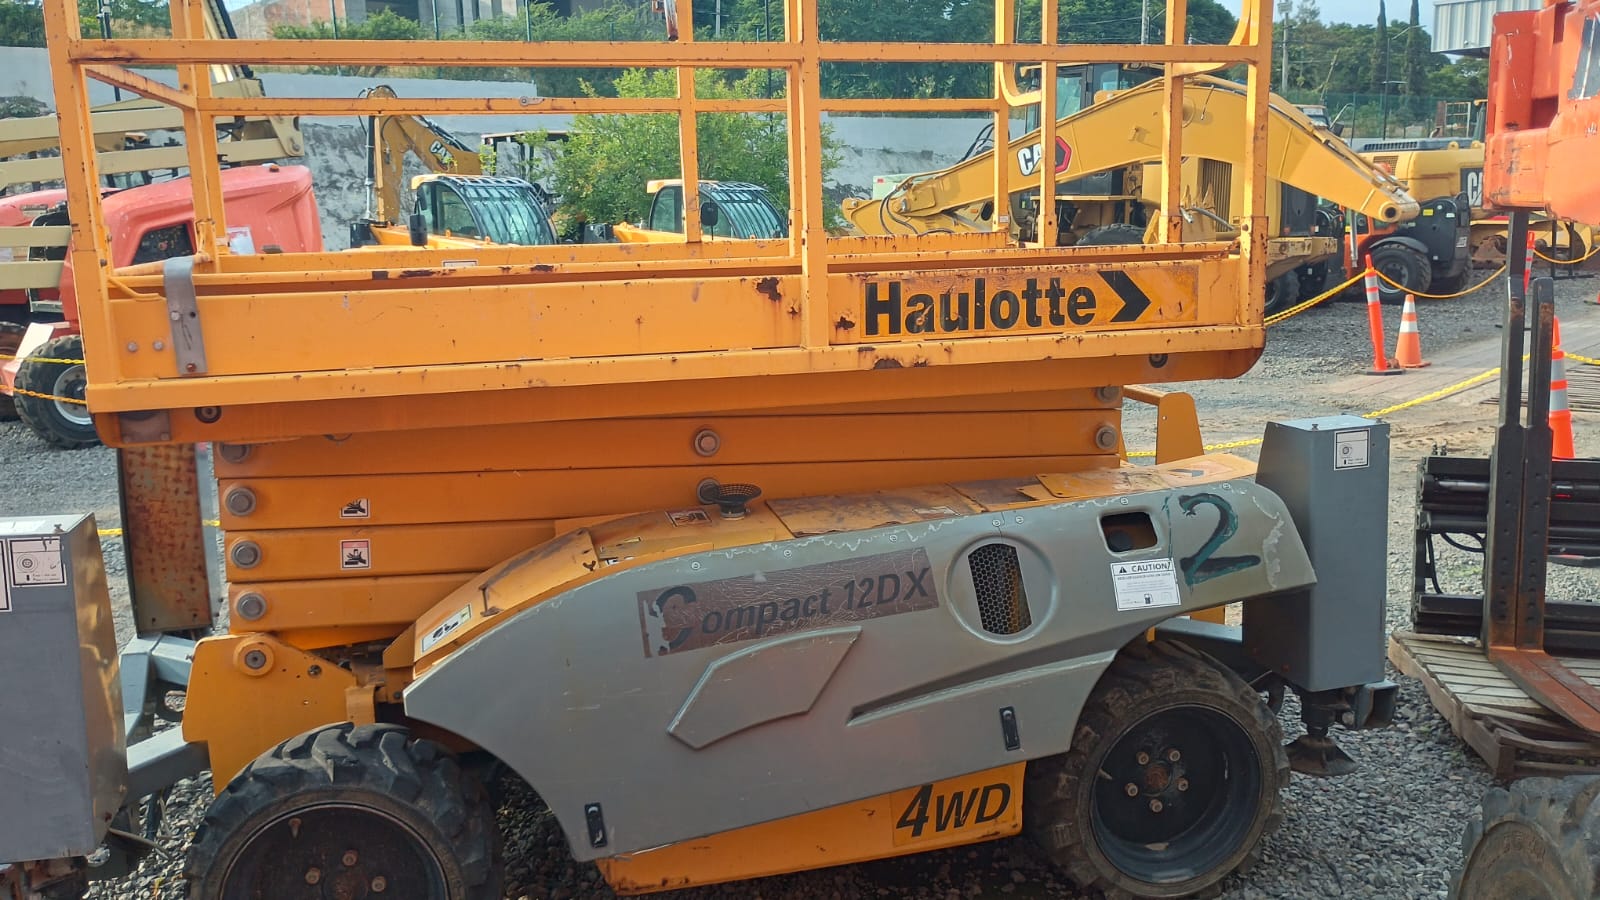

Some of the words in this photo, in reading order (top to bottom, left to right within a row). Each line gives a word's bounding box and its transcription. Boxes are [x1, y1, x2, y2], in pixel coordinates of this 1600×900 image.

[1017, 142, 1042, 176] CA
[864, 276, 1097, 336] Haulotte
[1131, 562, 1168, 573] CAUTION
[648, 585, 832, 653] Compact
[843, 566, 930, 610] 12DX
[895, 782, 1012, 838] 4WD
